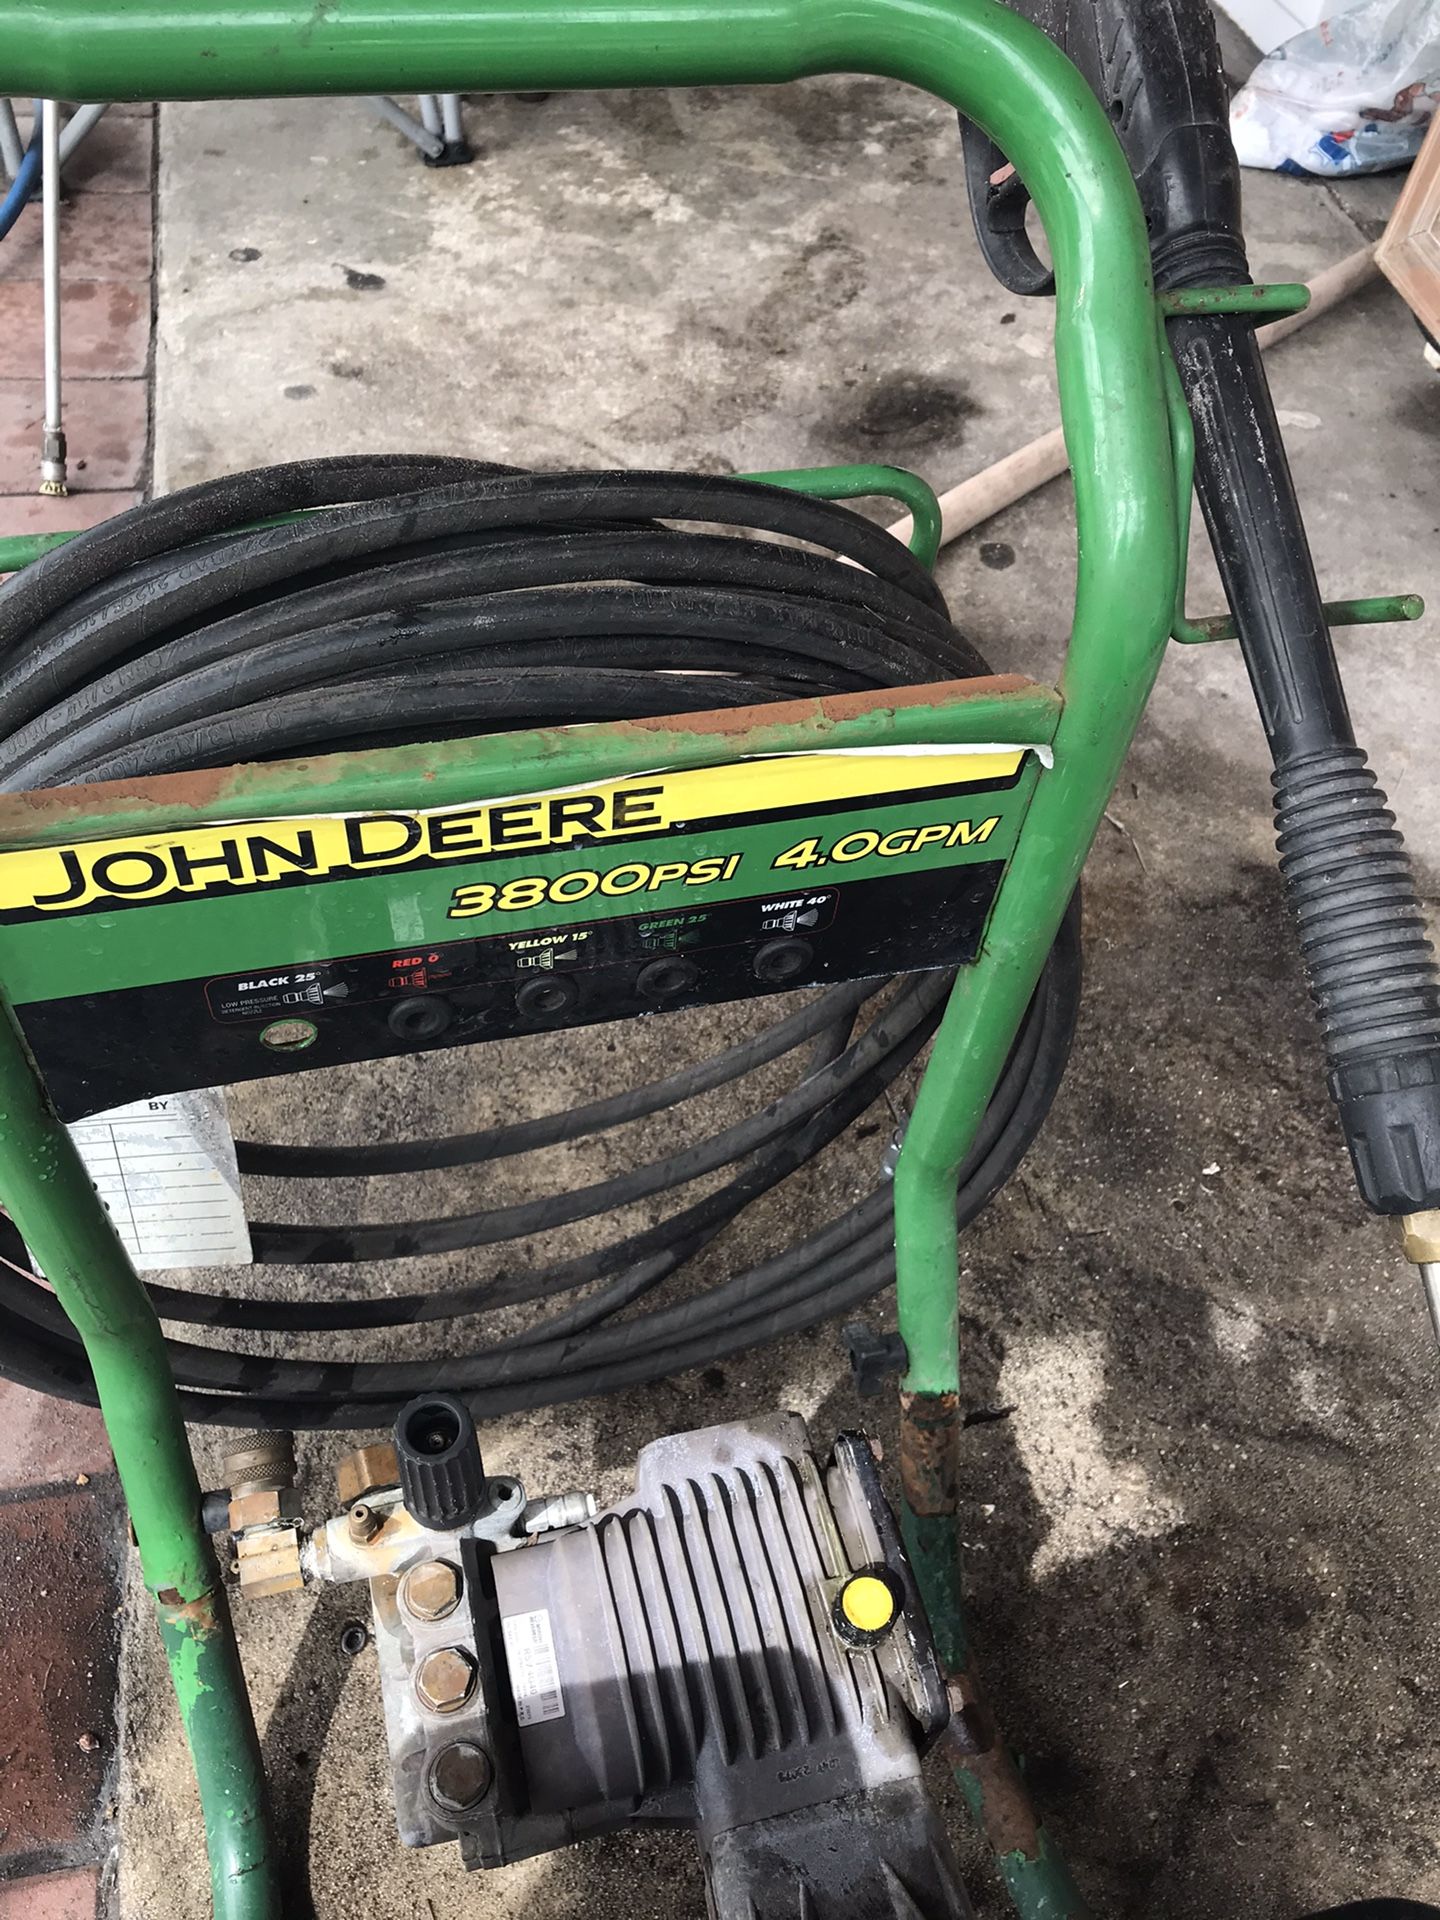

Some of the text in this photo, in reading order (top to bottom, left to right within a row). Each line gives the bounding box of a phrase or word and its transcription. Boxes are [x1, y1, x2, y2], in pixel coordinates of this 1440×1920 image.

[34, 786, 664, 906] JOHN DEERE
[448, 816, 1001, 920] 3800PSI 4.0GPM
[761, 894, 832, 912] WHITE 40°
[638, 917, 686, 932] GREEN
[508, 934, 569, 951] YELLOW
[392, 957, 423, 968] RED
[238, 975, 290, 992] BLACK
[221, 994, 279, 1010] LOW PRESSURE
[148, 1100, 169, 1112] BY
